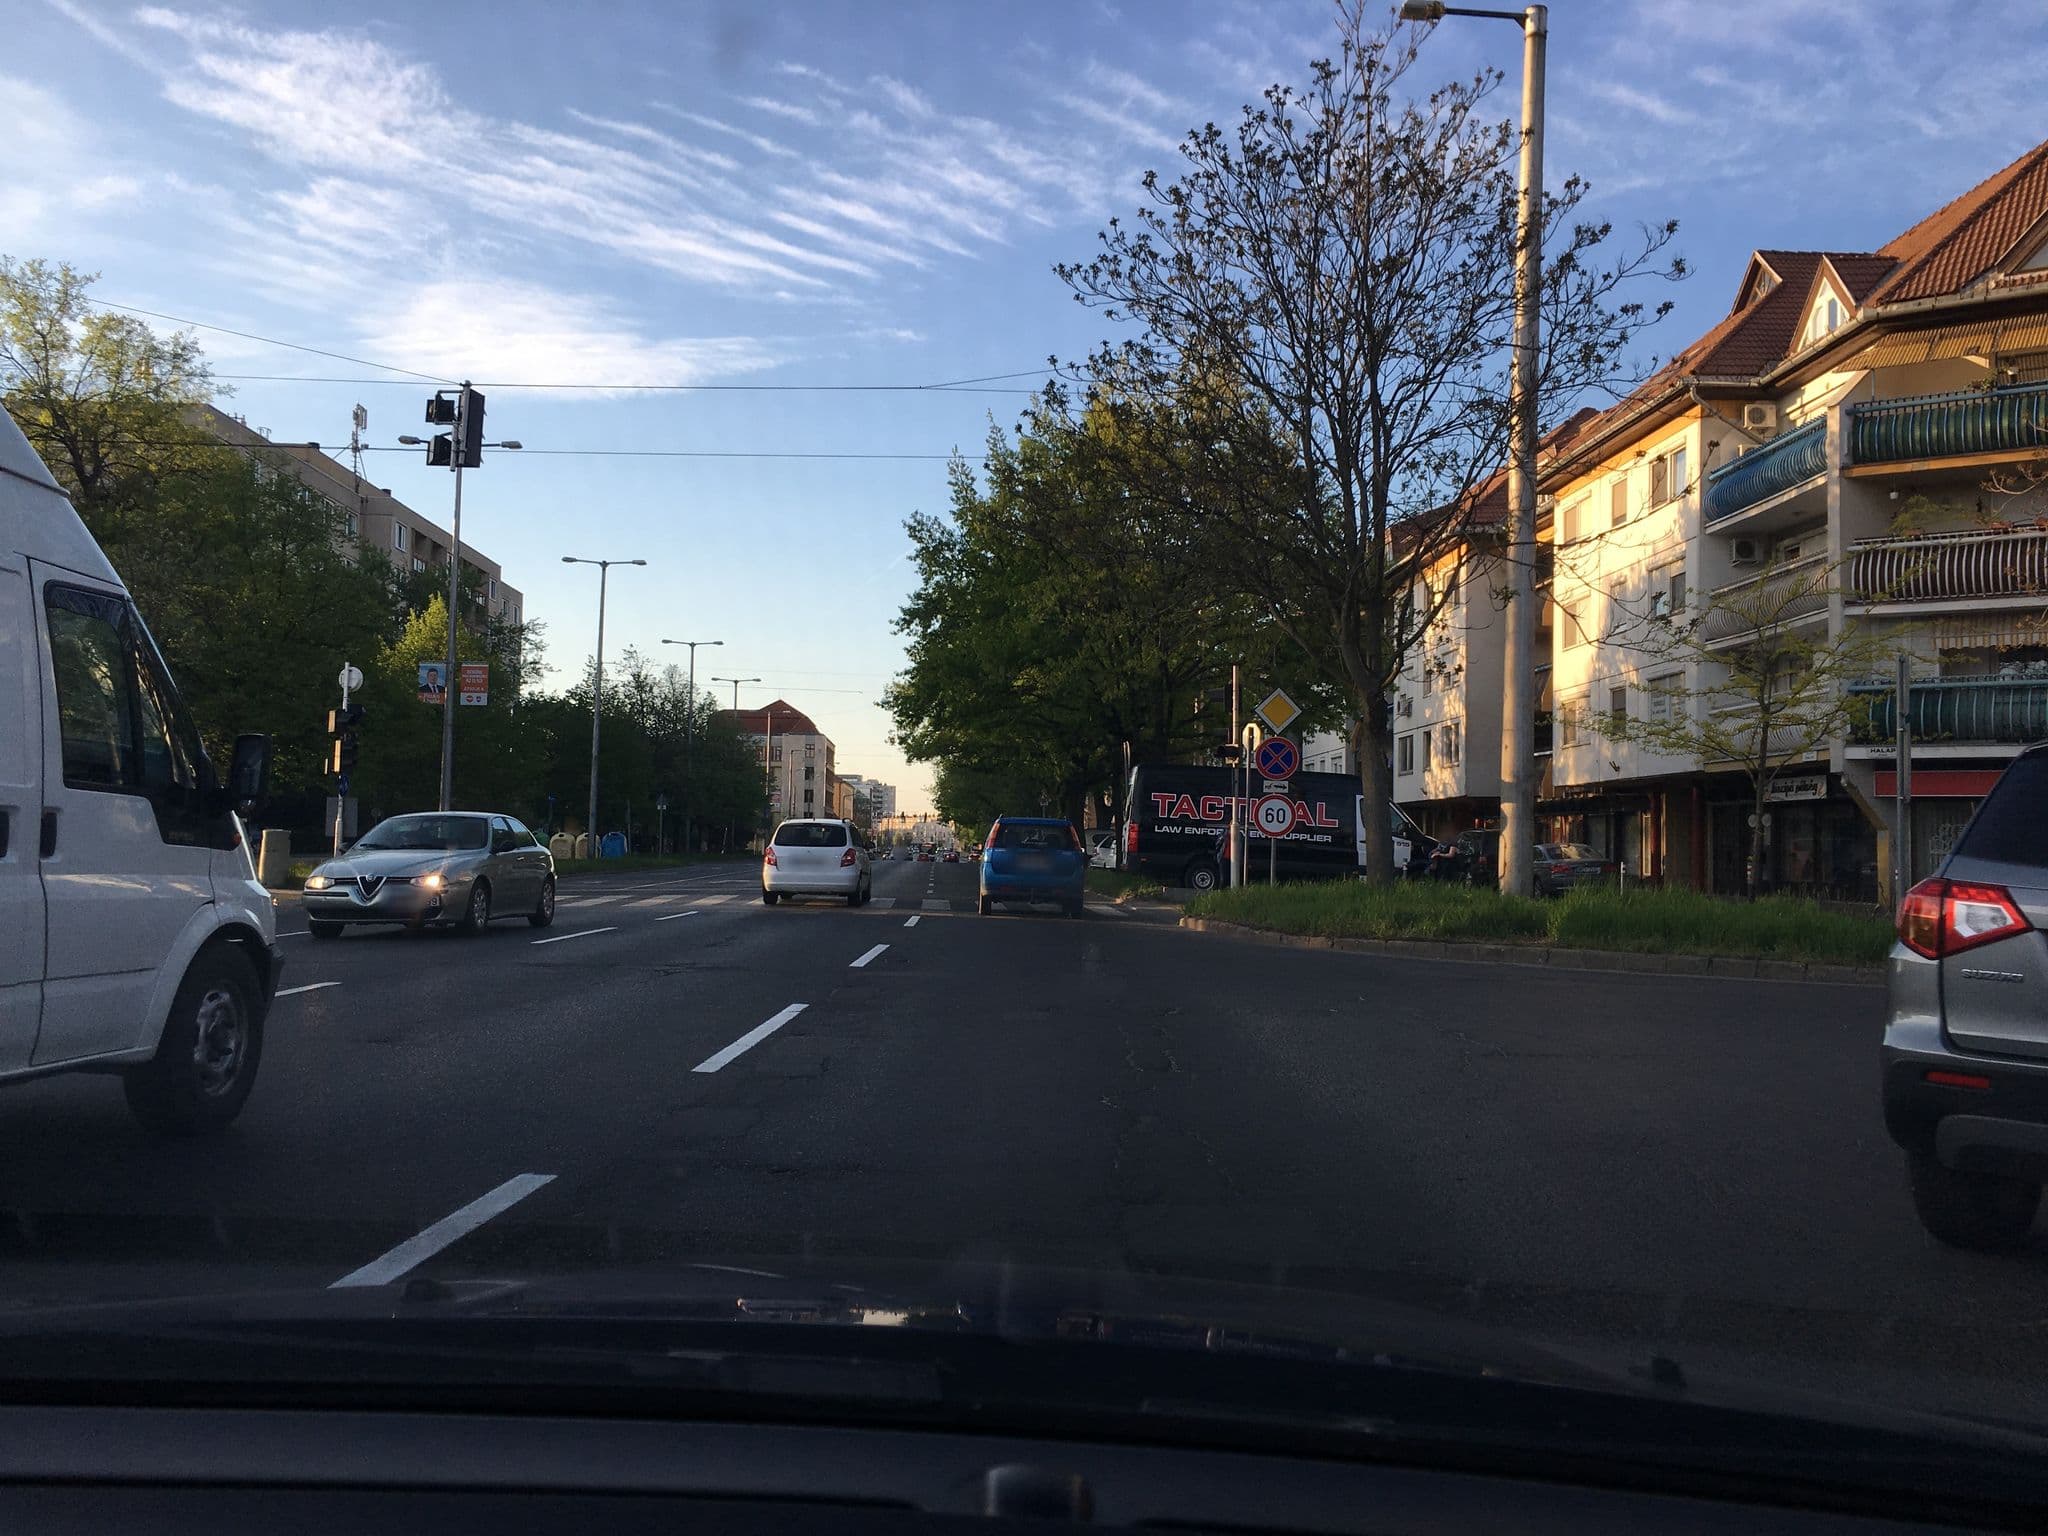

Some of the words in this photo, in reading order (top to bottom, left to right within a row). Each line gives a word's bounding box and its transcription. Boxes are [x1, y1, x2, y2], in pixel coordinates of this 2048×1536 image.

[1151, 792, 1339, 828] TACTIAL
[1265, 807, 1286, 823] 60
[1154, 824, 1182, 834] LAW
[1277, 833, 1332, 843] UPPLIER
